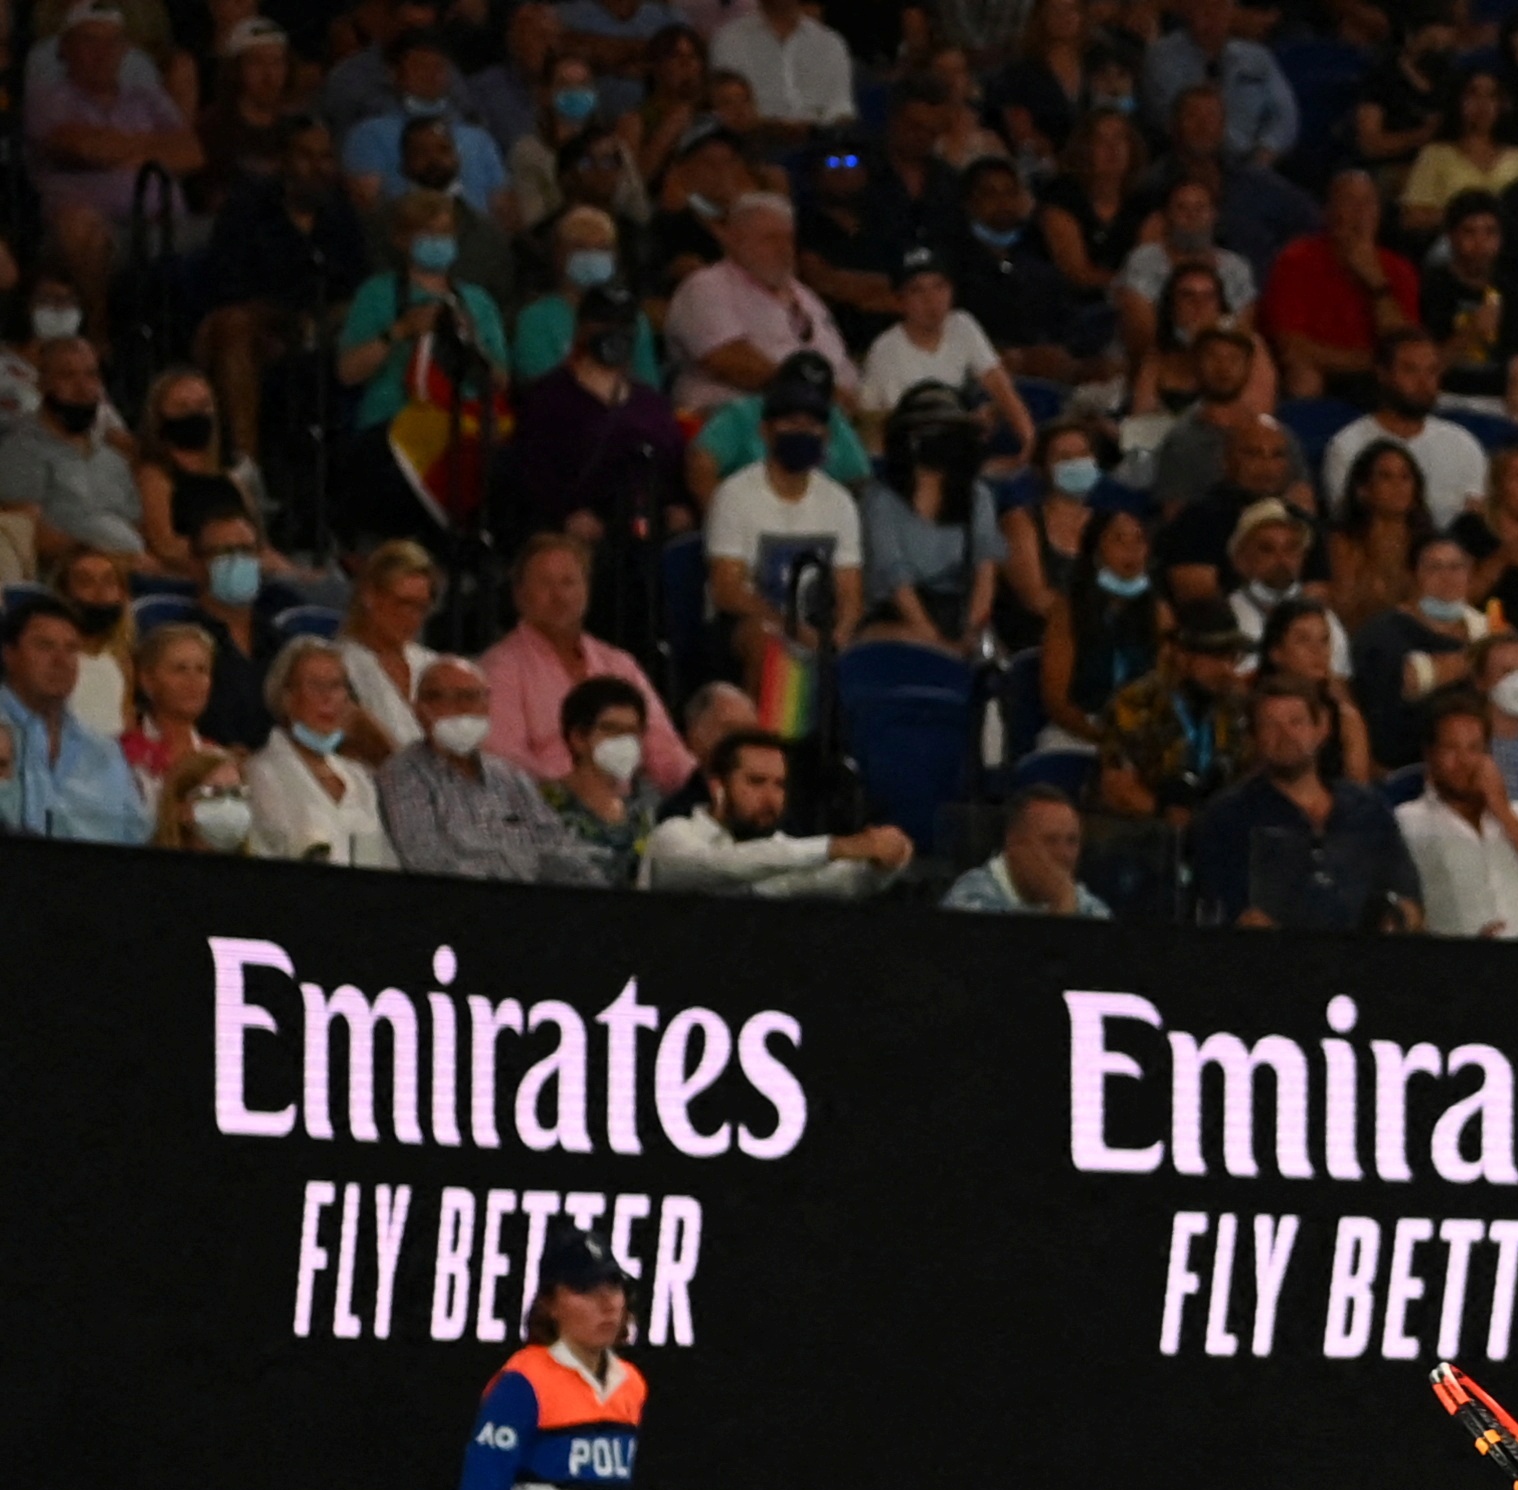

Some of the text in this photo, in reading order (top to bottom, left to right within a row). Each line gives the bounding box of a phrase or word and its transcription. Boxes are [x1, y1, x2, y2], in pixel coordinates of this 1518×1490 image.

[208, 937, 806, 1159] Emirates
[294, 1181, 411, 1340] FLY
[1160, 1212, 1299, 1356] FLY
[477, 1422, 517, 1449] AO
